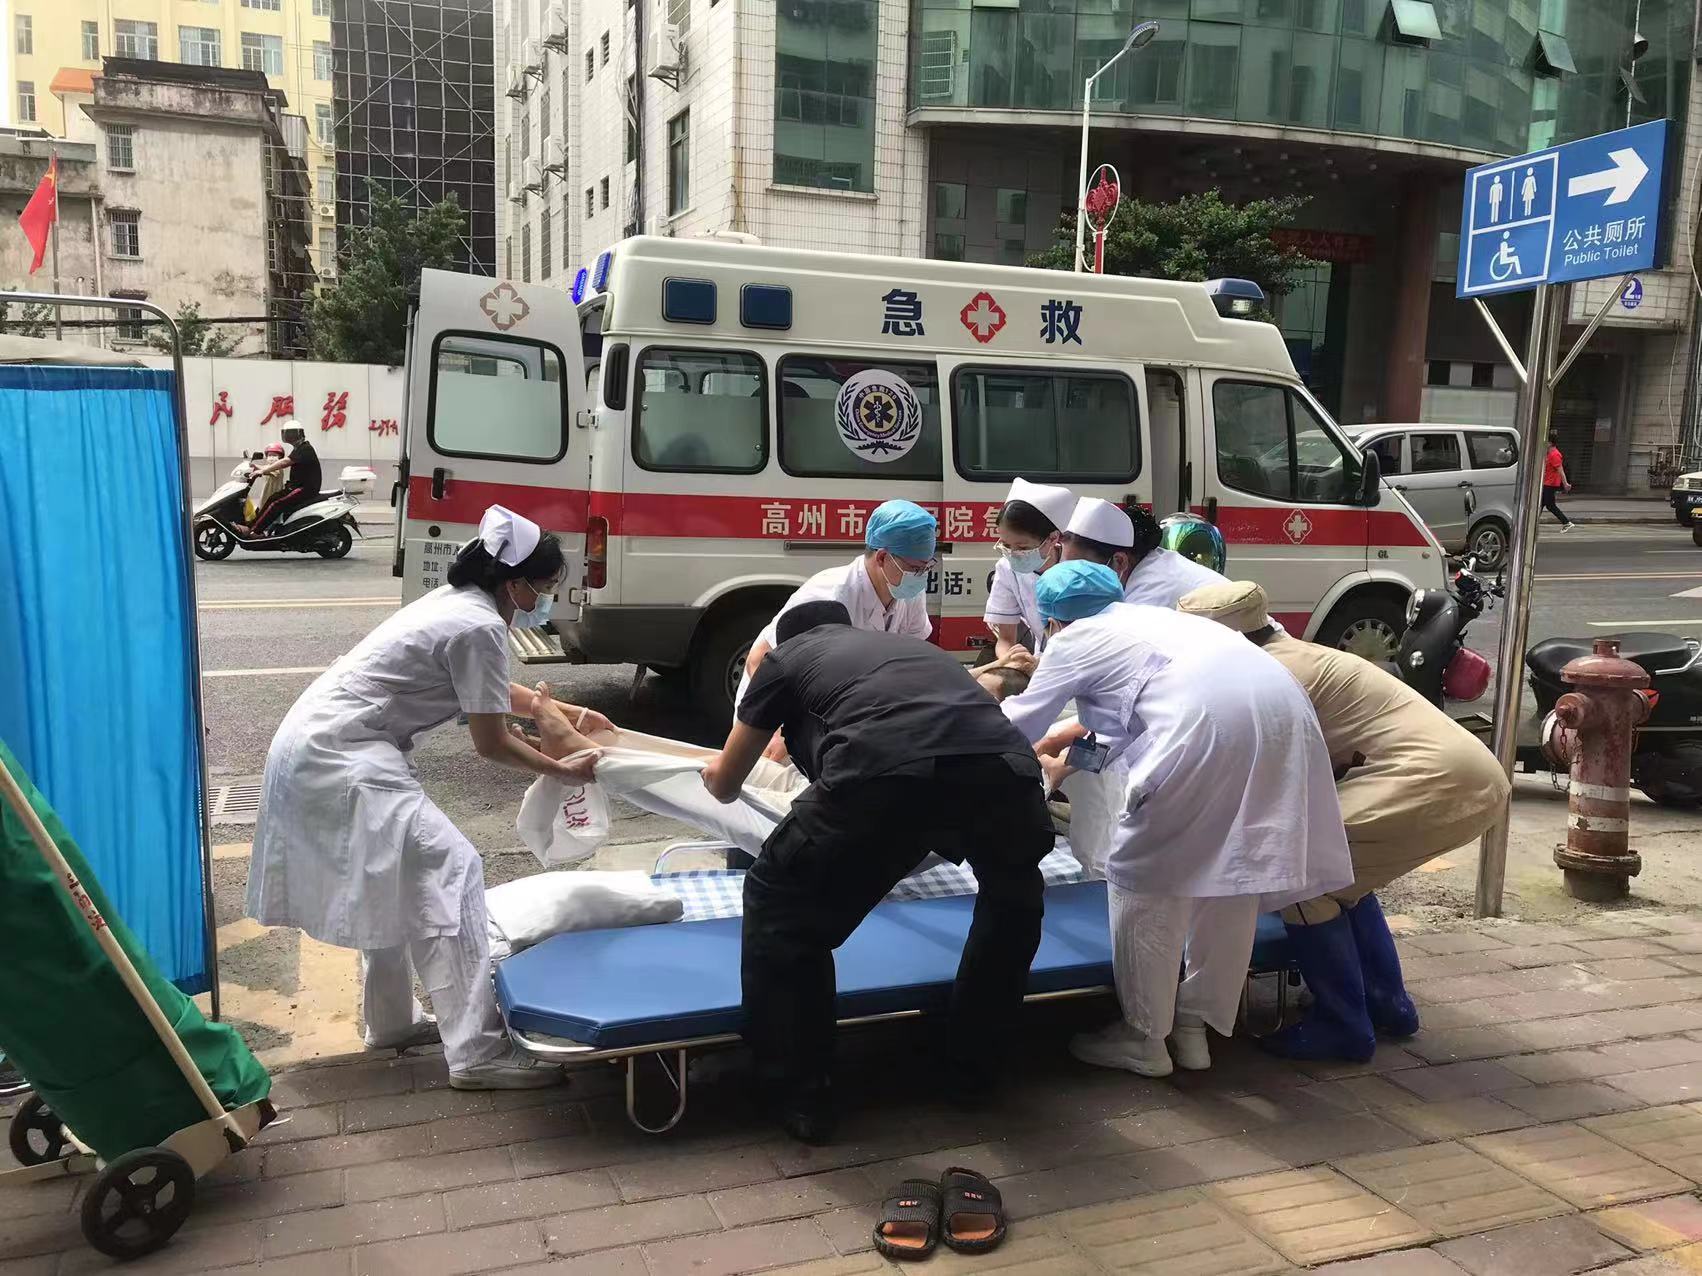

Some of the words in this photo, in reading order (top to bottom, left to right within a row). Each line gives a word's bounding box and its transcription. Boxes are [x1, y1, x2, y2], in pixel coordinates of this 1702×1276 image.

[1563, 216, 1646, 251] 公共厕所
[1564, 250, 1601, 266] Public
[1604, 243, 1639, 259] Toilet
